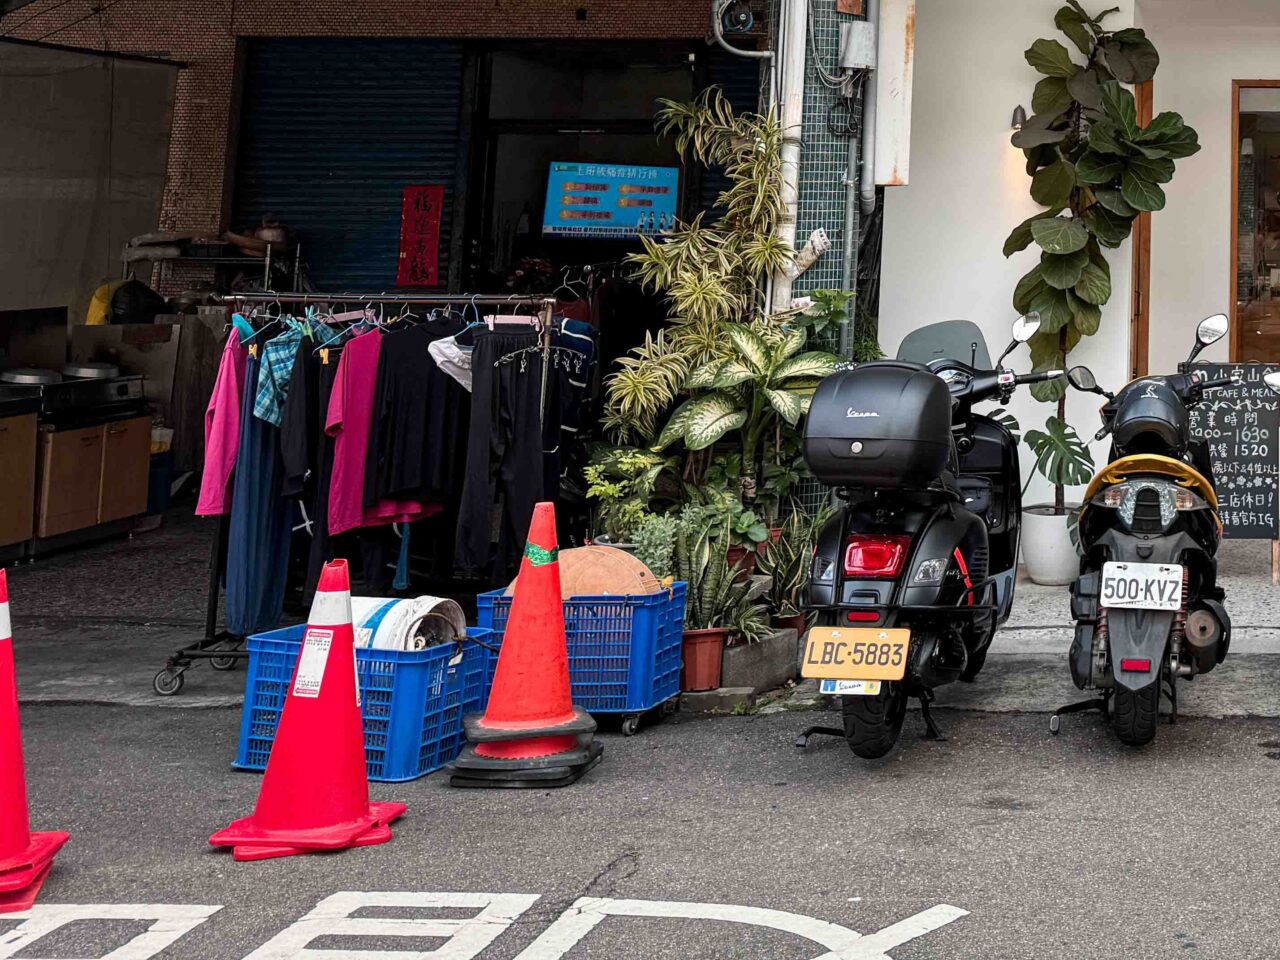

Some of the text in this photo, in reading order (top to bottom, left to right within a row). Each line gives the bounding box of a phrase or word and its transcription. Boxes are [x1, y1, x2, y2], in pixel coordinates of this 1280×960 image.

[1217, 388, 1239, 399] CAFE
[1241, 386, 1249, 397] &
[1251, 387, 1276, 398] MEAL
[1234, 444, 1269, 457] 1520
